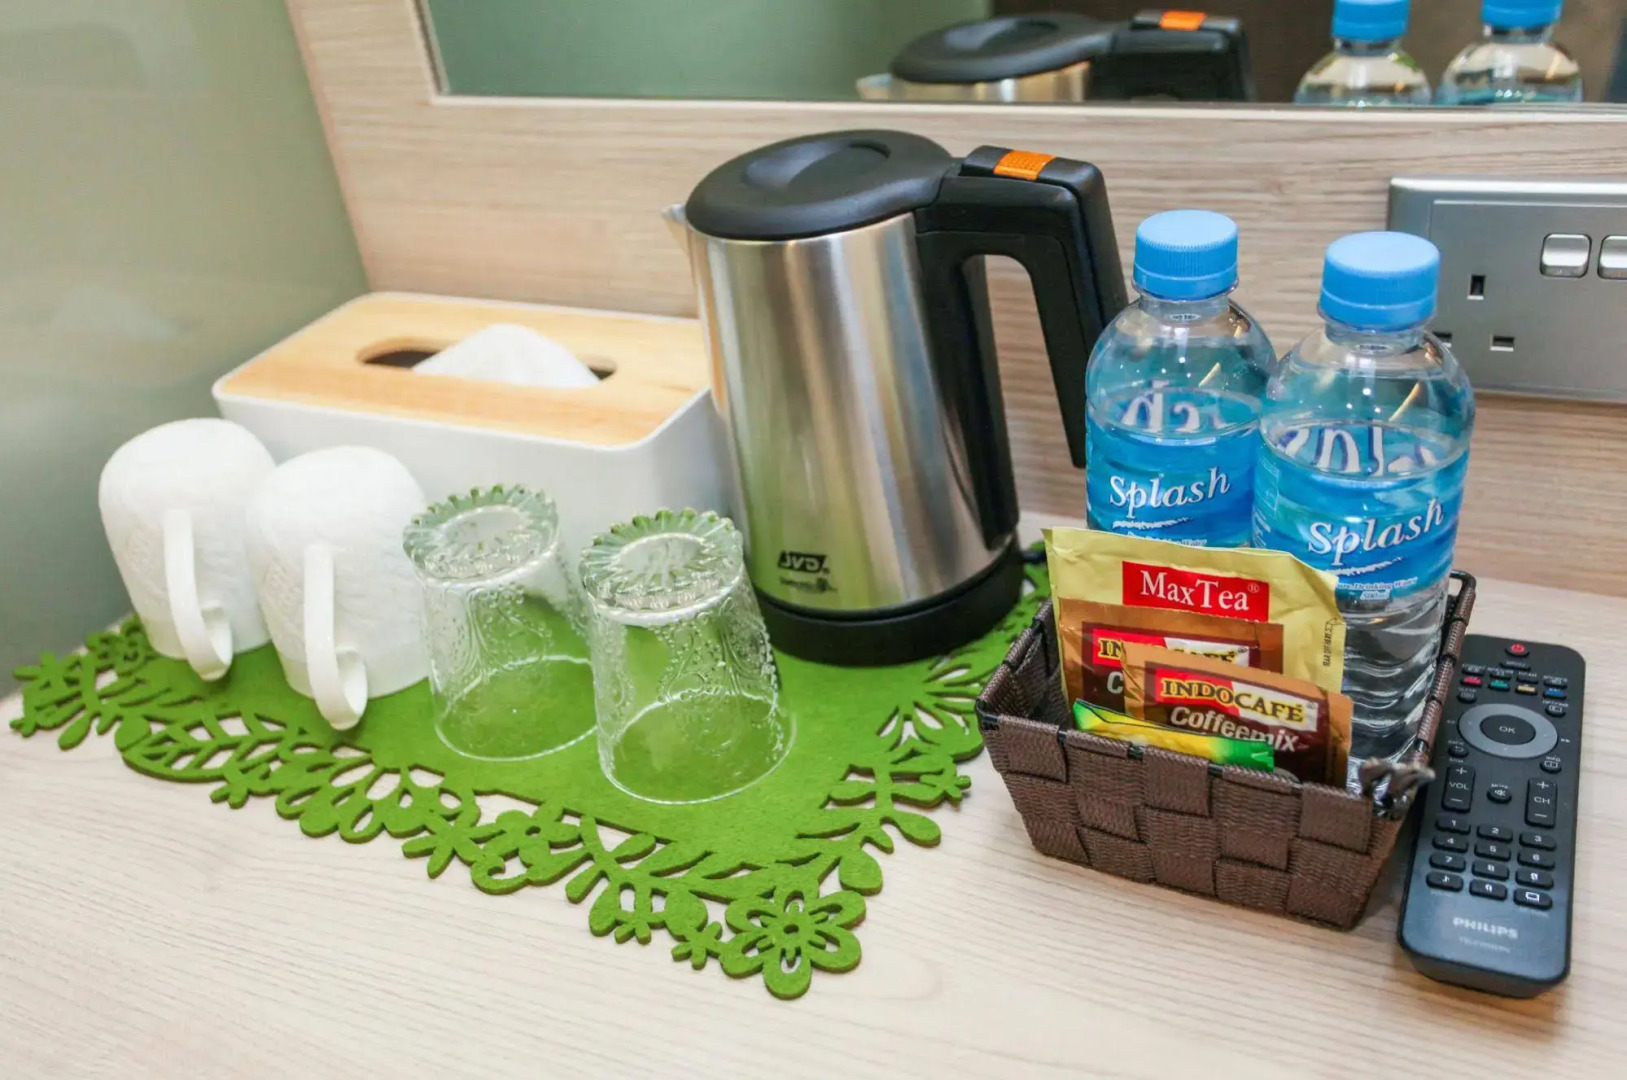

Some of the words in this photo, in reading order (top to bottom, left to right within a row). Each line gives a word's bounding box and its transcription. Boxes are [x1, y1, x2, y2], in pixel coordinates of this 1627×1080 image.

[1109, 466, 1231, 519] Splash
[1307, 497, 1445, 566] Splash
[1139, 569, 1250, 611] MaxTea
[1170, 705, 1300, 752] Coffeemix
[1499, 725, 1516, 734] OK
[1449, 782, 1469, 790] VOL
[1533, 795, 1551, 805] CH
[1491, 827, 1500, 835] 2
[1447, 837, 1455, 845] 4
[1489, 845, 1497, 853] 5
[1532, 853, 1540, 861] 6
[1452, 916, 1519, 939] PHILIPS
